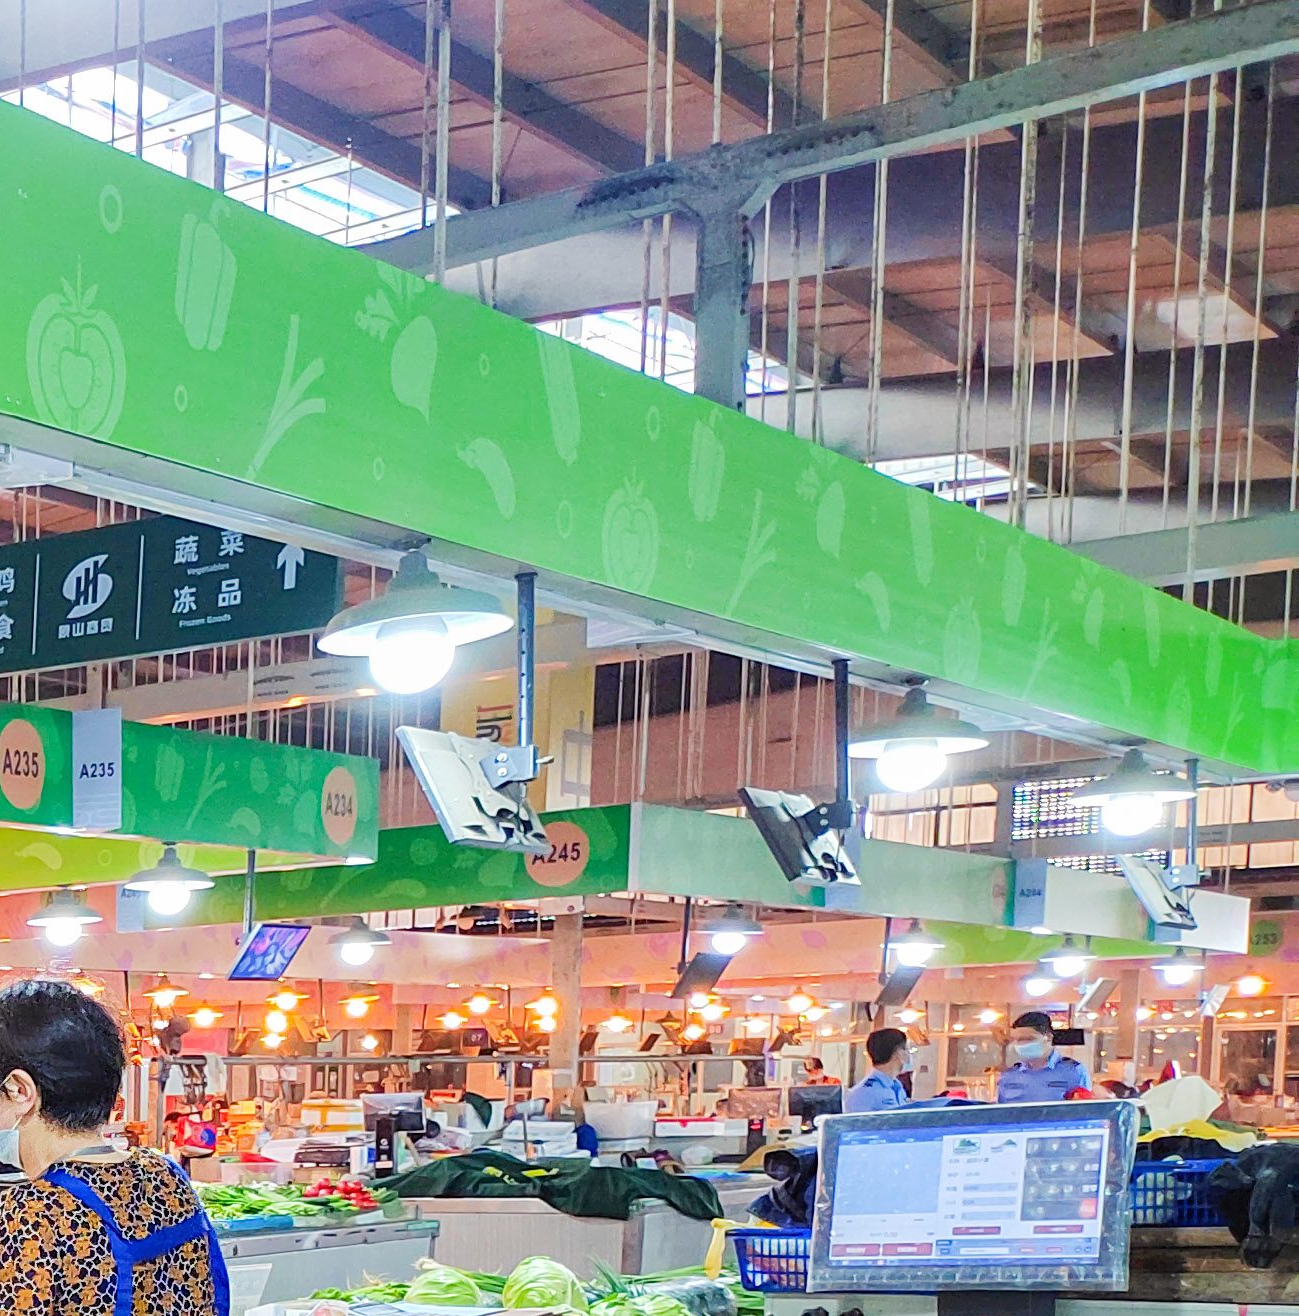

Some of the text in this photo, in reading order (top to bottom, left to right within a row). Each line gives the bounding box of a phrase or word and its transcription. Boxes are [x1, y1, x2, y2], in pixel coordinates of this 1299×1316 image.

[173, 531, 245, 564] 蔬菜
[171, 578, 242, 613] 冻品
[3, 748, 39, 778] A235
[79, 762, 114, 779] A235
[325, 792, 353, 817] A234
